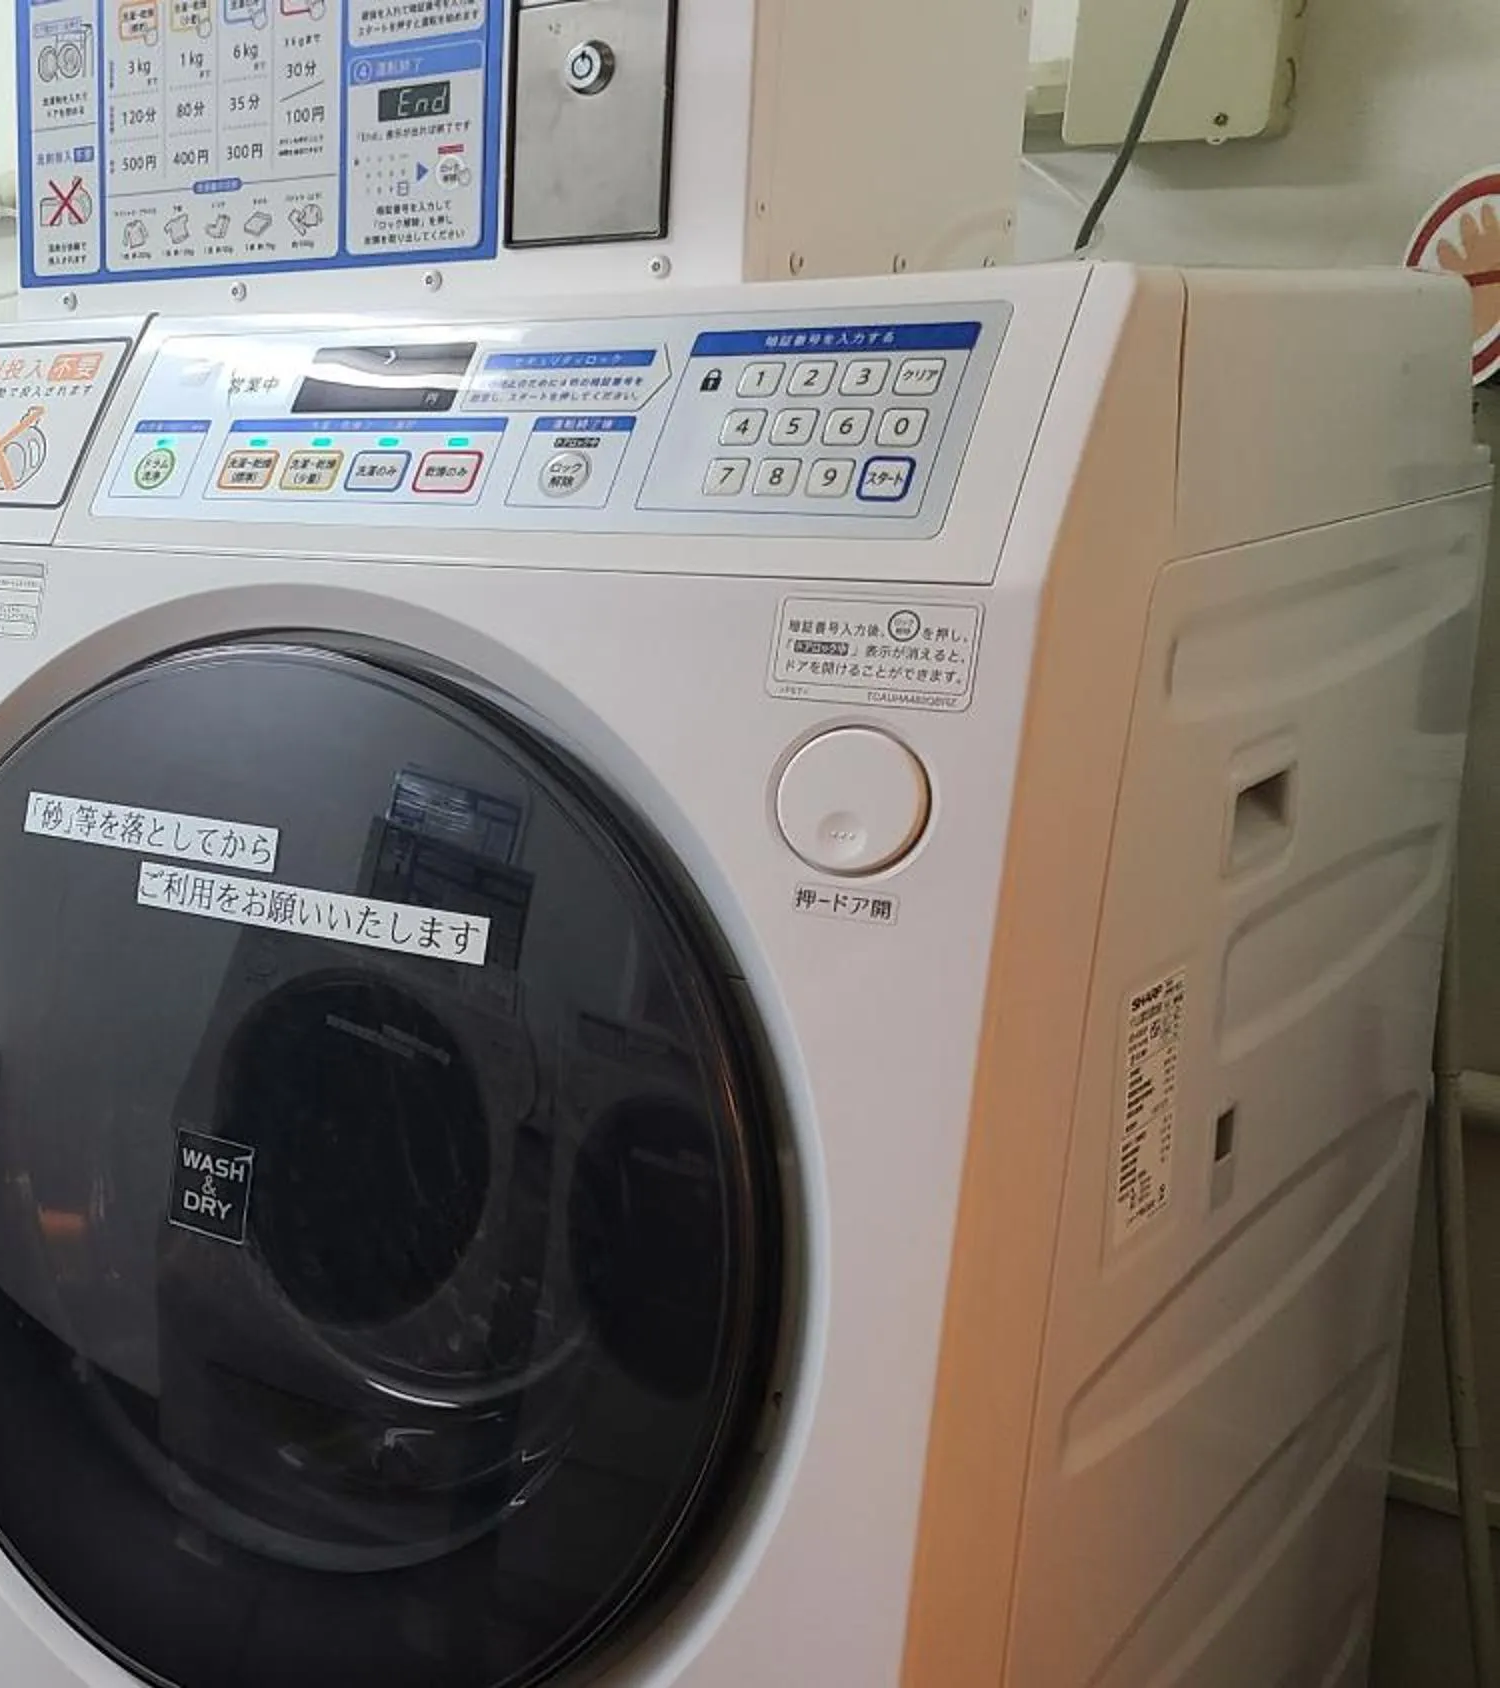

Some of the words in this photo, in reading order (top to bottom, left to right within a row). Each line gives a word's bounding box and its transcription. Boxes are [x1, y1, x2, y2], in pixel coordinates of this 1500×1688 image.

[285, 60, 317, 79] 30分
[229, 94, 260, 111] 35分
[398, 85, 448, 117] End
[123, 107, 157, 126] 120分
[286, 105, 325, 124] 100円
[173, 150, 209, 165] 400円
[227, 143, 263, 160] 300円
[122, 155, 157, 172] 500円
[764, 332, 896, 348] 暗証番号を入力する
[55, 359, 102, 380] 不要
[756, 370, 765, 387] 1
[803, 369, 820, 386] 2
[856, 367, 872, 386] 3
[902, 368, 940, 383] クリア
[735, 417, 750, 435] 4
[786, 417, 801, 435] 5
[838, 417, 854, 435] 6
[893, 416, 910, 436] 0
[549, 463, 583, 474] ロック
[719, 467, 735, 485] 7
[768, 467, 785, 486] 8
[822, 467, 838, 487] 9
[864, 469, 905, 487] スタート
[548, 475, 575, 489] 解除
[788, 620, 886, 638] 暗証番号入力後、
[785, 659, 963, 685] ドアを開けることができます。
[32, 796, 272, 866] 「砂」等を落としてから
[139, 868, 481, 956] ご利用をお願いいたします
[182, 1147, 244, 1182] WASH
[201, 1174, 217, 1198] &
[183, 1188, 232, 1220] DRY
